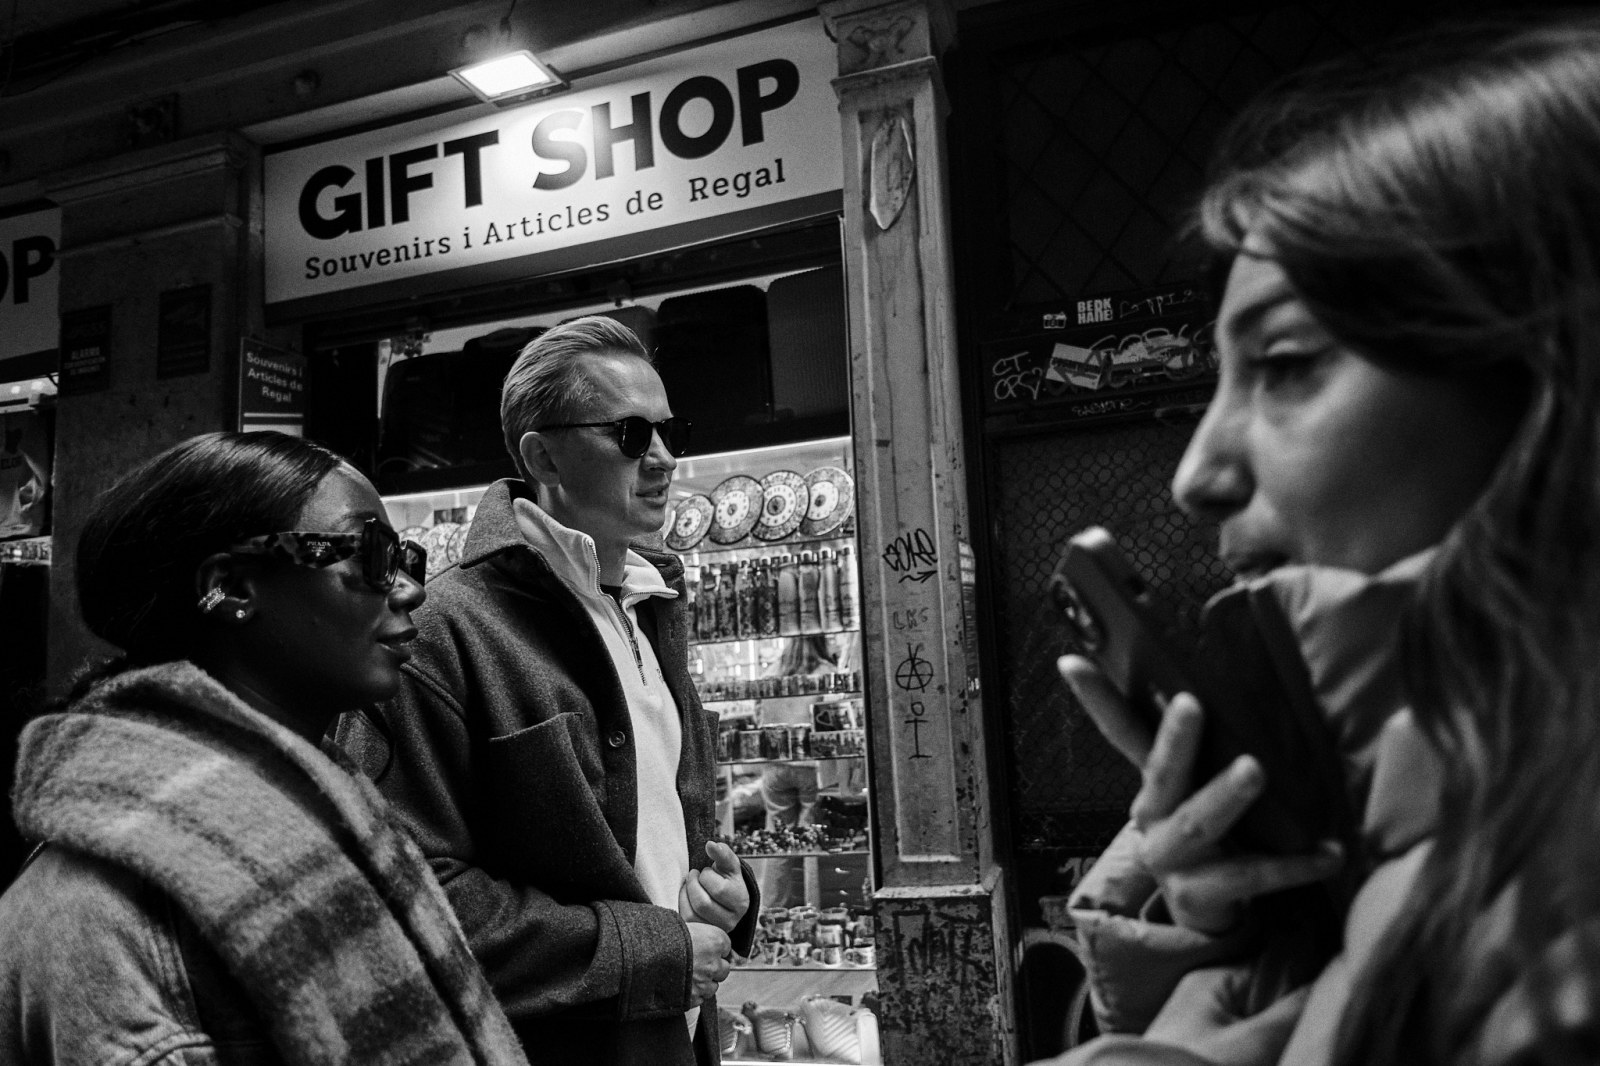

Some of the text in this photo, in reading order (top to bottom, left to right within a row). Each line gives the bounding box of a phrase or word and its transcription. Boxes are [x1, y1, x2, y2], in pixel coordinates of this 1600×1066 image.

[298, 58, 800, 240] GIFT SHOP
[305, 158, 786, 280] Souvenirs i Articles de Regal
[246, 351, 297, 376] Souvenirs
[247, 368, 303, 392] Articles de
[262, 385, 292, 403] Regal
